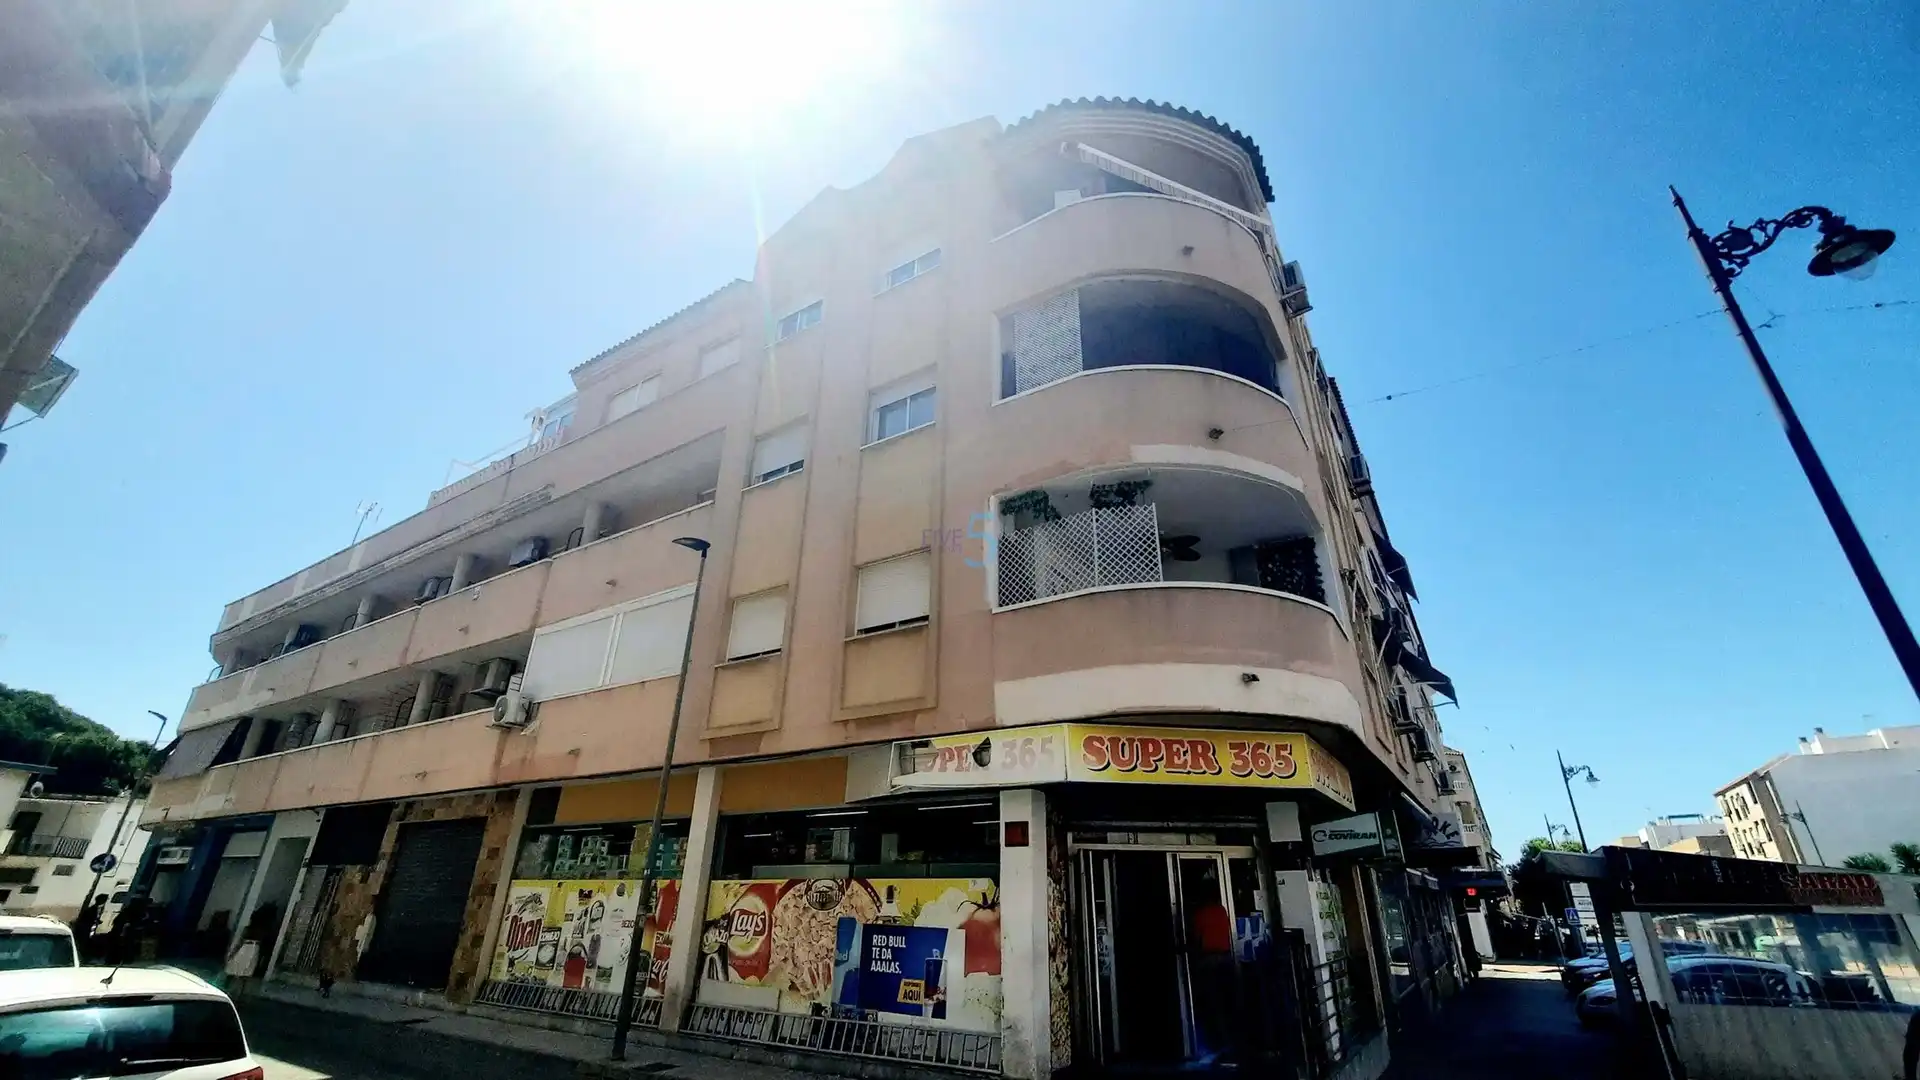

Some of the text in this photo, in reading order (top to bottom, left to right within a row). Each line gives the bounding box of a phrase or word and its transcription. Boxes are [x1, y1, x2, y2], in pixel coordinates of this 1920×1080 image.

[1001, 736, 1054, 769] 365
[1082, 734, 1223, 775] SUPER
[1227, 740, 1298, 779] 365
[730, 910, 765, 944] Lay's
[872, 934, 906, 948] RED BULL
[872, 947, 892, 960] TE DA
[870, 960, 902, 974] AAALAS.
